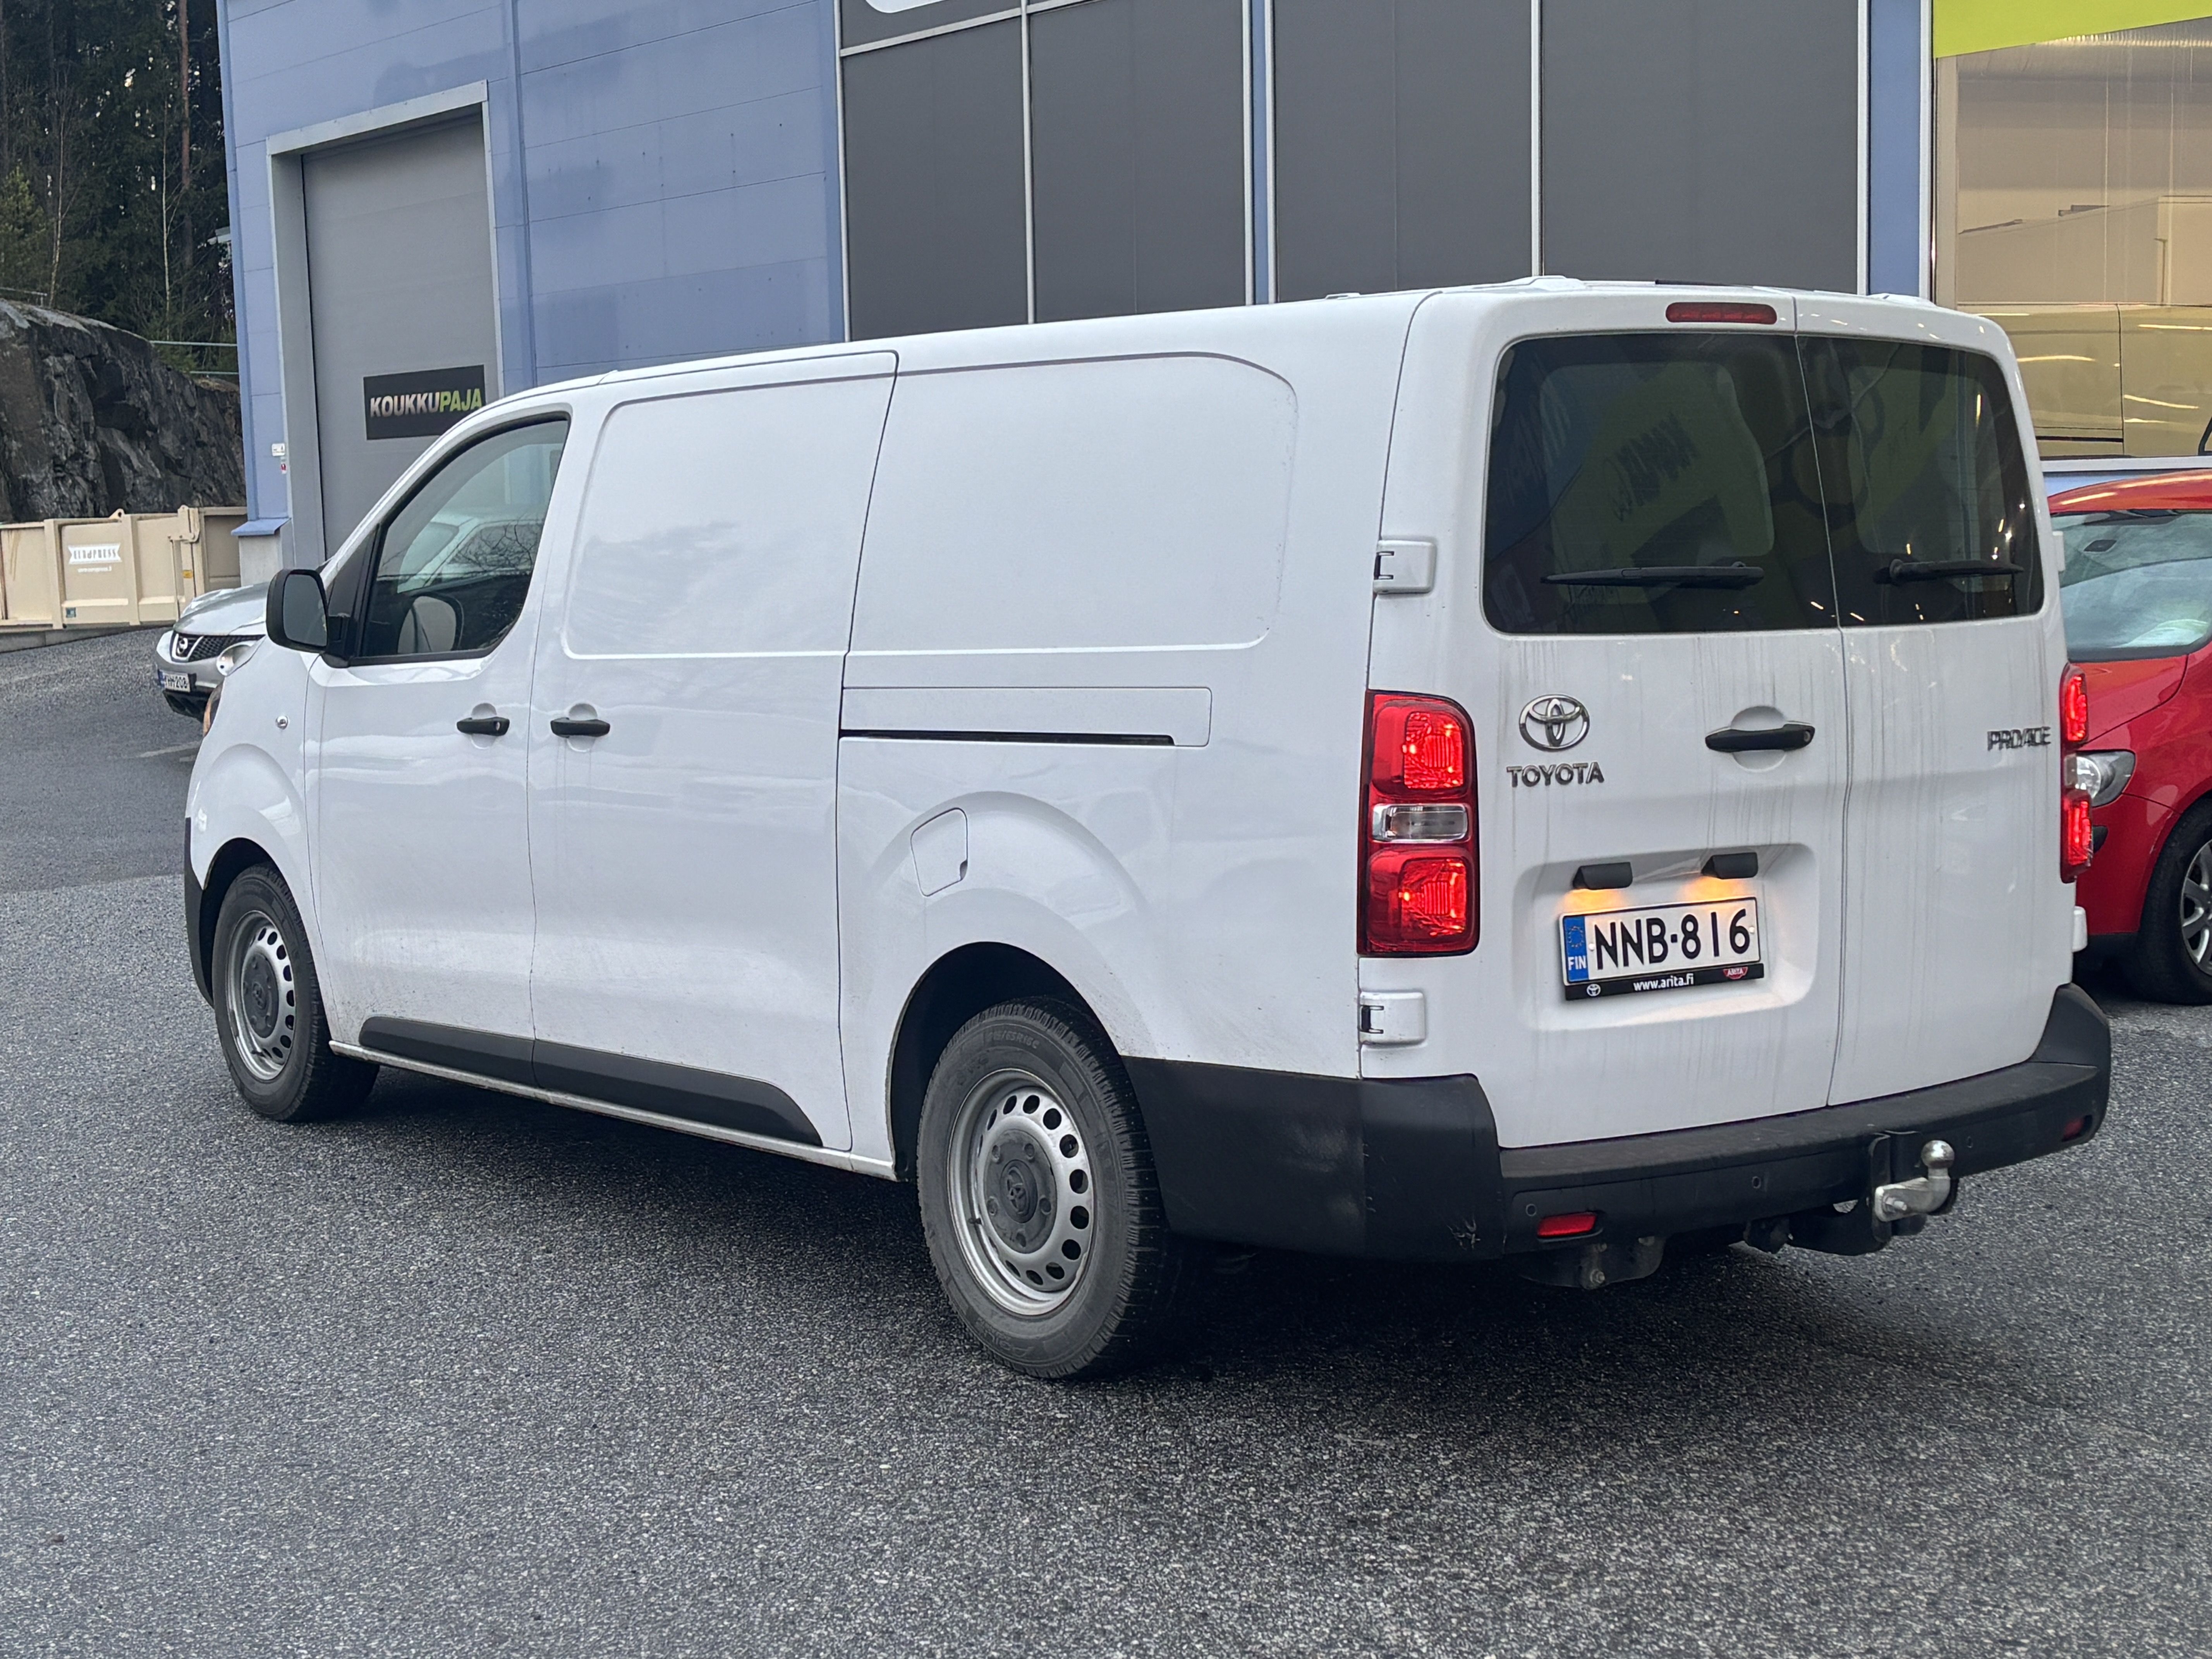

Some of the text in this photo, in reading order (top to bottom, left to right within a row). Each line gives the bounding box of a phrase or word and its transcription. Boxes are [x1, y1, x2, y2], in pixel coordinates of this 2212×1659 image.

[370, 388, 483, 418] KOUKKUPAJA
[1987, 726, 2051, 752] PROACE
[1506, 761, 1605, 788] TOYOTA
[1594, 908, 1750, 970] NNB-816
[1568, 955, 1587, 970] FIN
[1633, 973, 1694, 991] www.arita.fi
